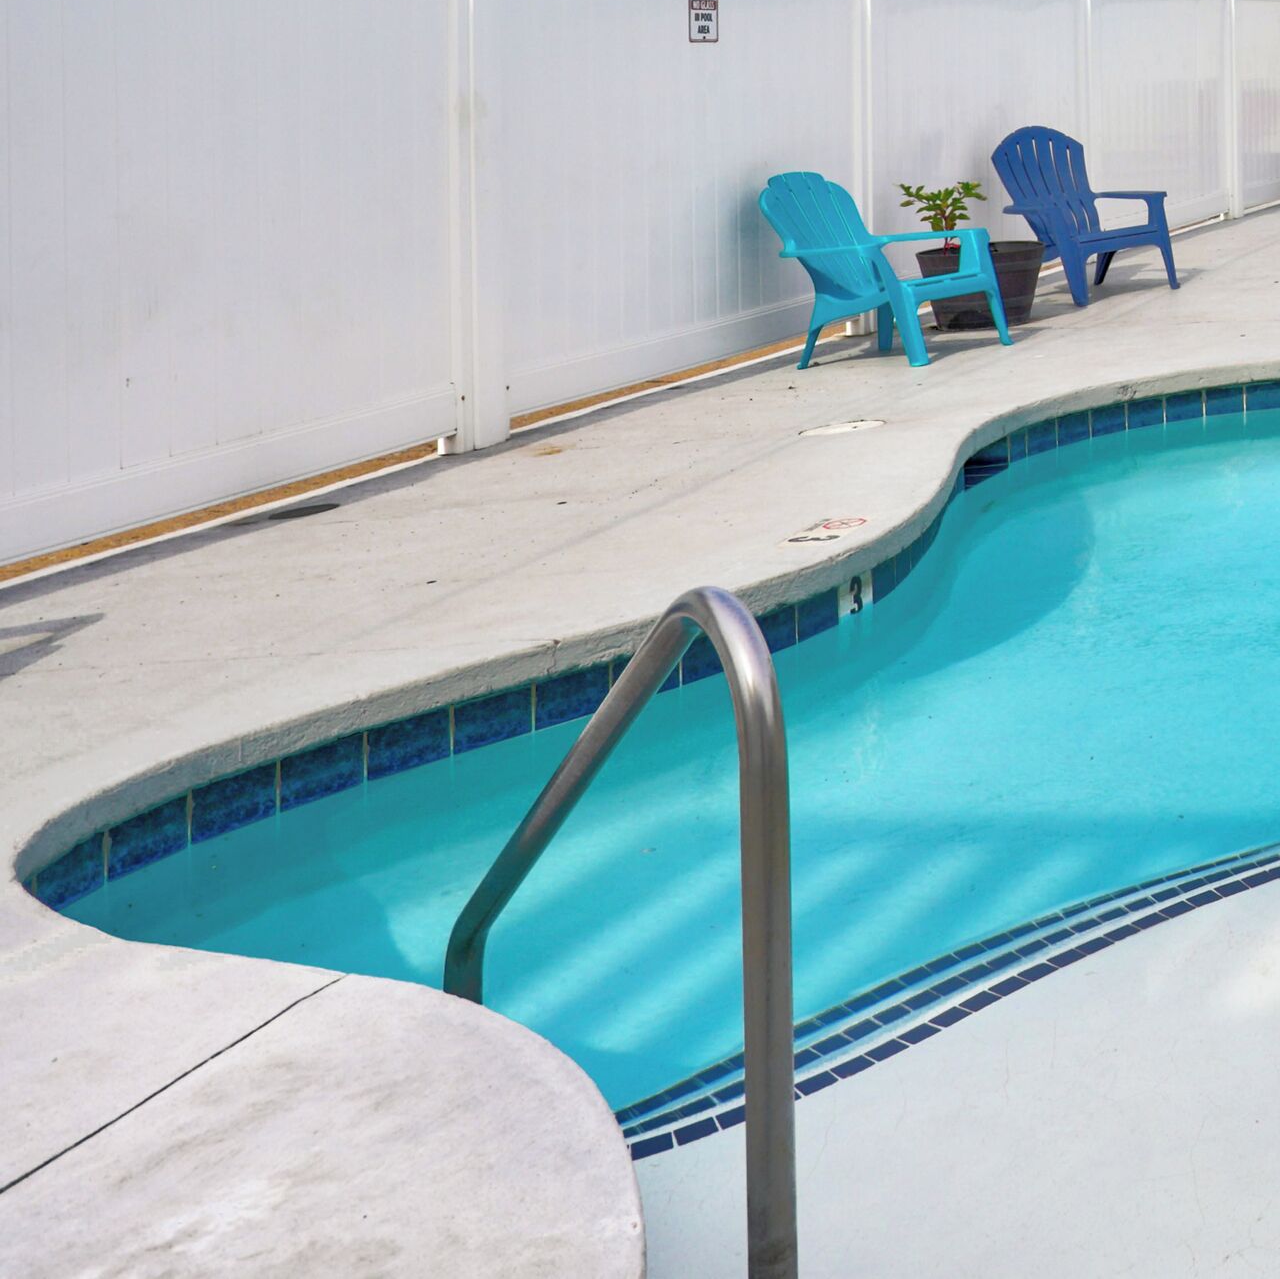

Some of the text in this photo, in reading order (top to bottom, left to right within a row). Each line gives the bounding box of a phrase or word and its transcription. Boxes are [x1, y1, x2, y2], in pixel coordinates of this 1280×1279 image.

[701, 13, 713, 22] POOL
[697, 25, 710, 34] AREA
[849, 576, 863, 615] 3
